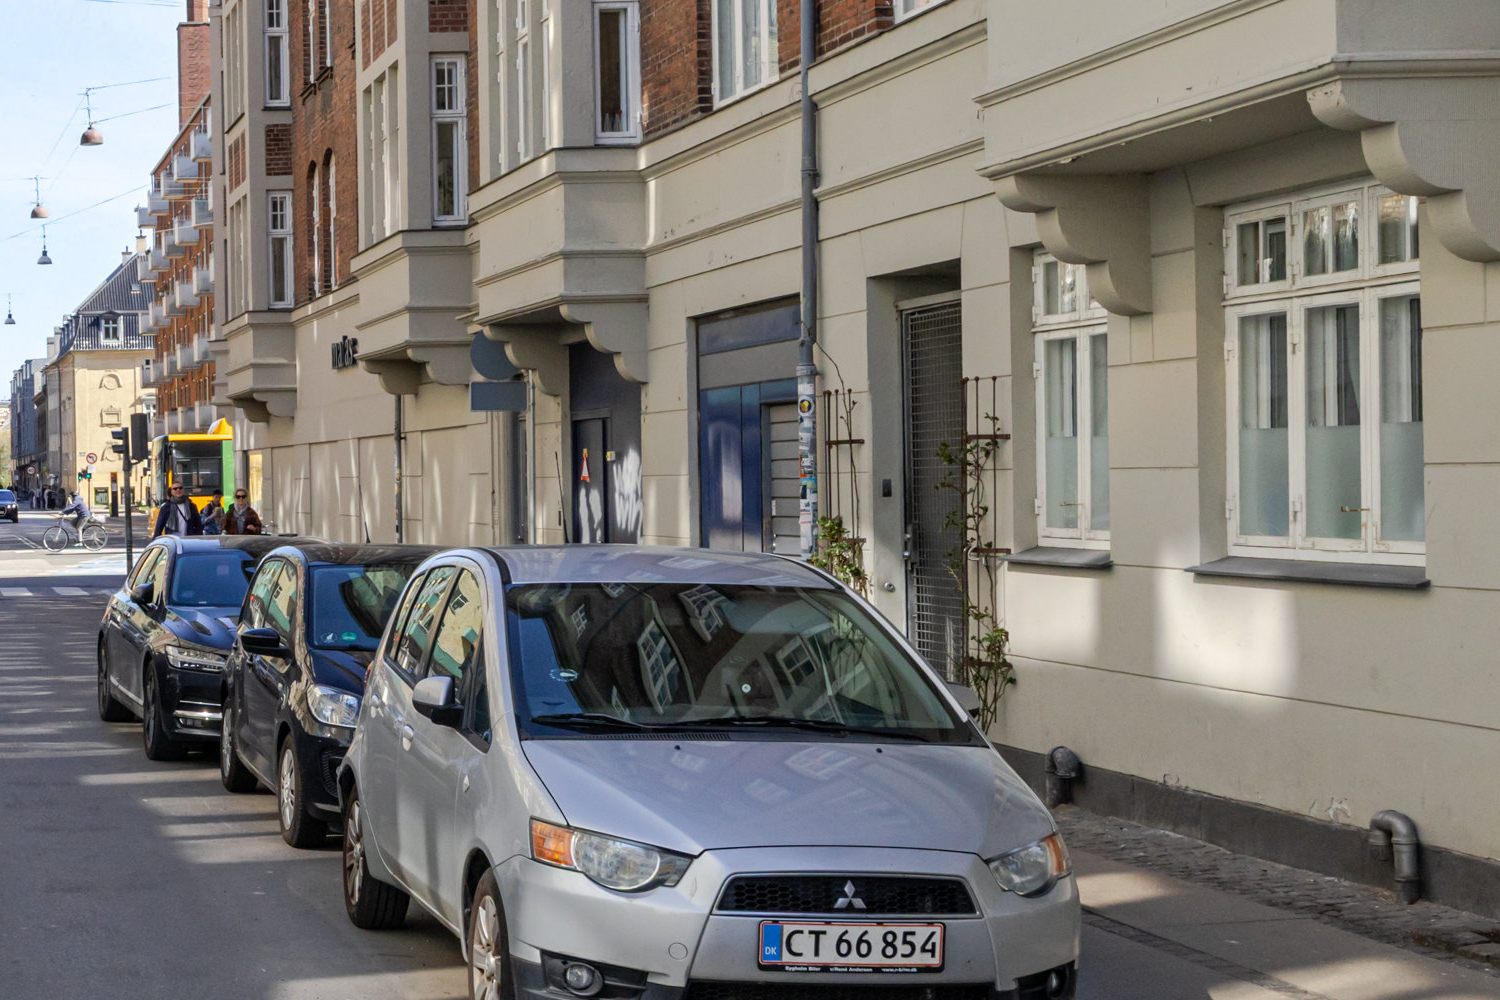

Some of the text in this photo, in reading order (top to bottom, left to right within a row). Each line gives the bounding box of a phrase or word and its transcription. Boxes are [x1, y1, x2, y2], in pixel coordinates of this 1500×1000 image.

[764, 946, 777, 956] DK
[785, 929, 937, 959] CT 66 854
